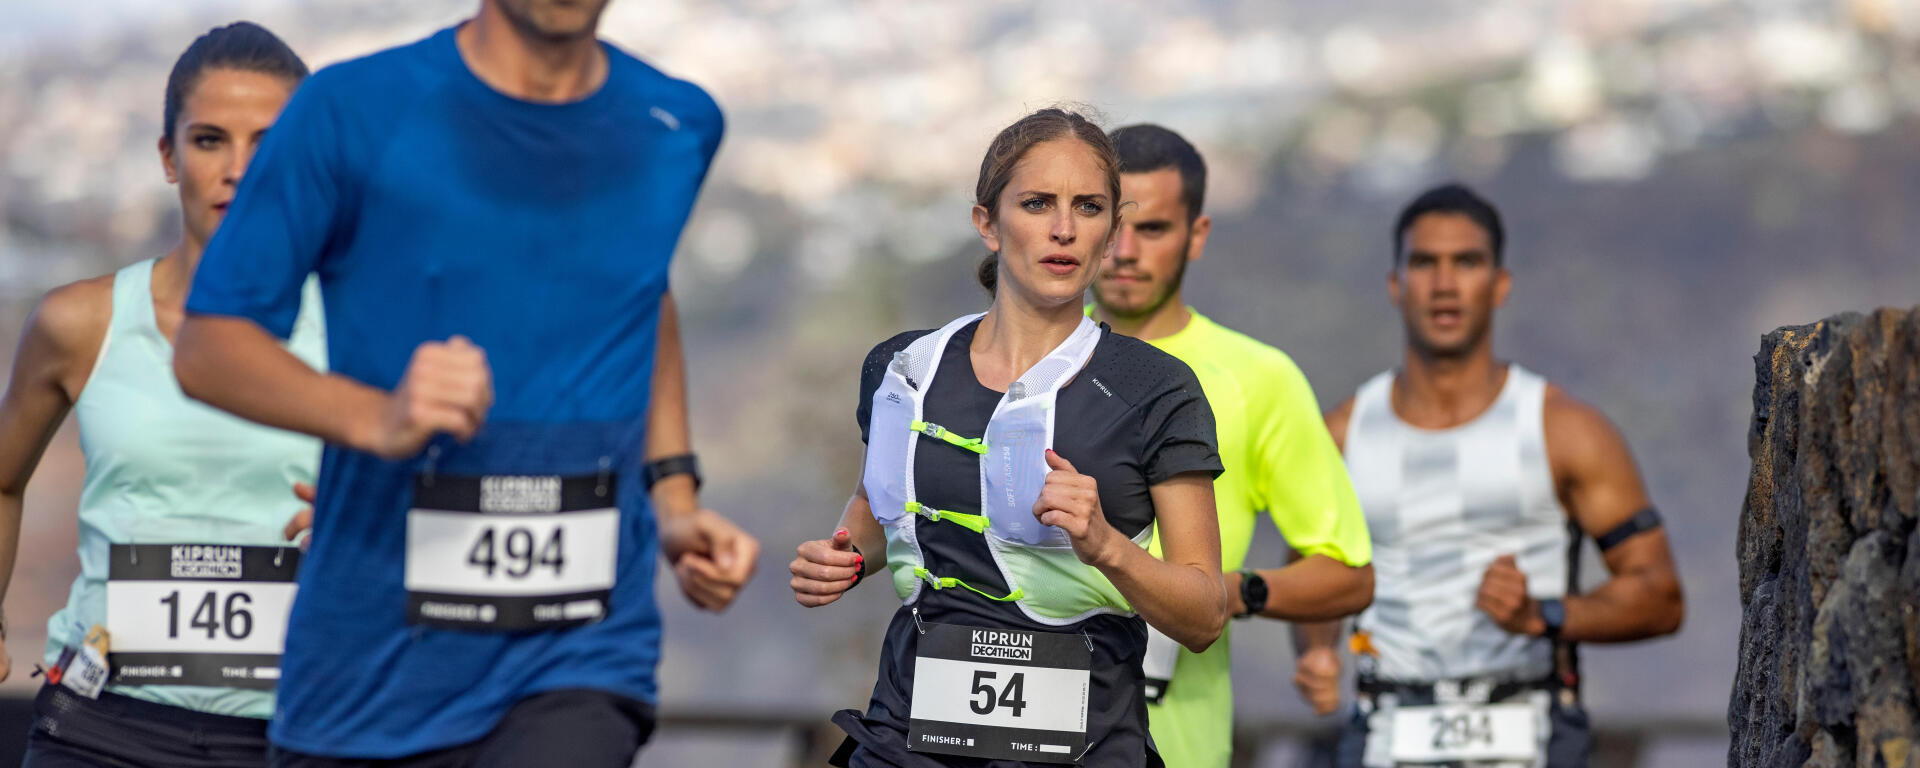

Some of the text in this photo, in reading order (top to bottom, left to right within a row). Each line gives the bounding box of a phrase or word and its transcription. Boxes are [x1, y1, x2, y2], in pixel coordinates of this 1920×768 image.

[1091, 377, 1112, 397] KIPRUN
[171, 546, 242, 561] KIPRUN
[467, 525, 565, 579] 494
[160, 591, 253, 640] 146
[972, 629, 1033, 647] KIPRUN
[972, 645, 1031, 660] DECATHLON
[969, 670, 1027, 718] 54
[922, 734, 961, 746] FINISHER
[1430, 712, 1493, 750] 294
[1011, 742, 1033, 752] TIME
